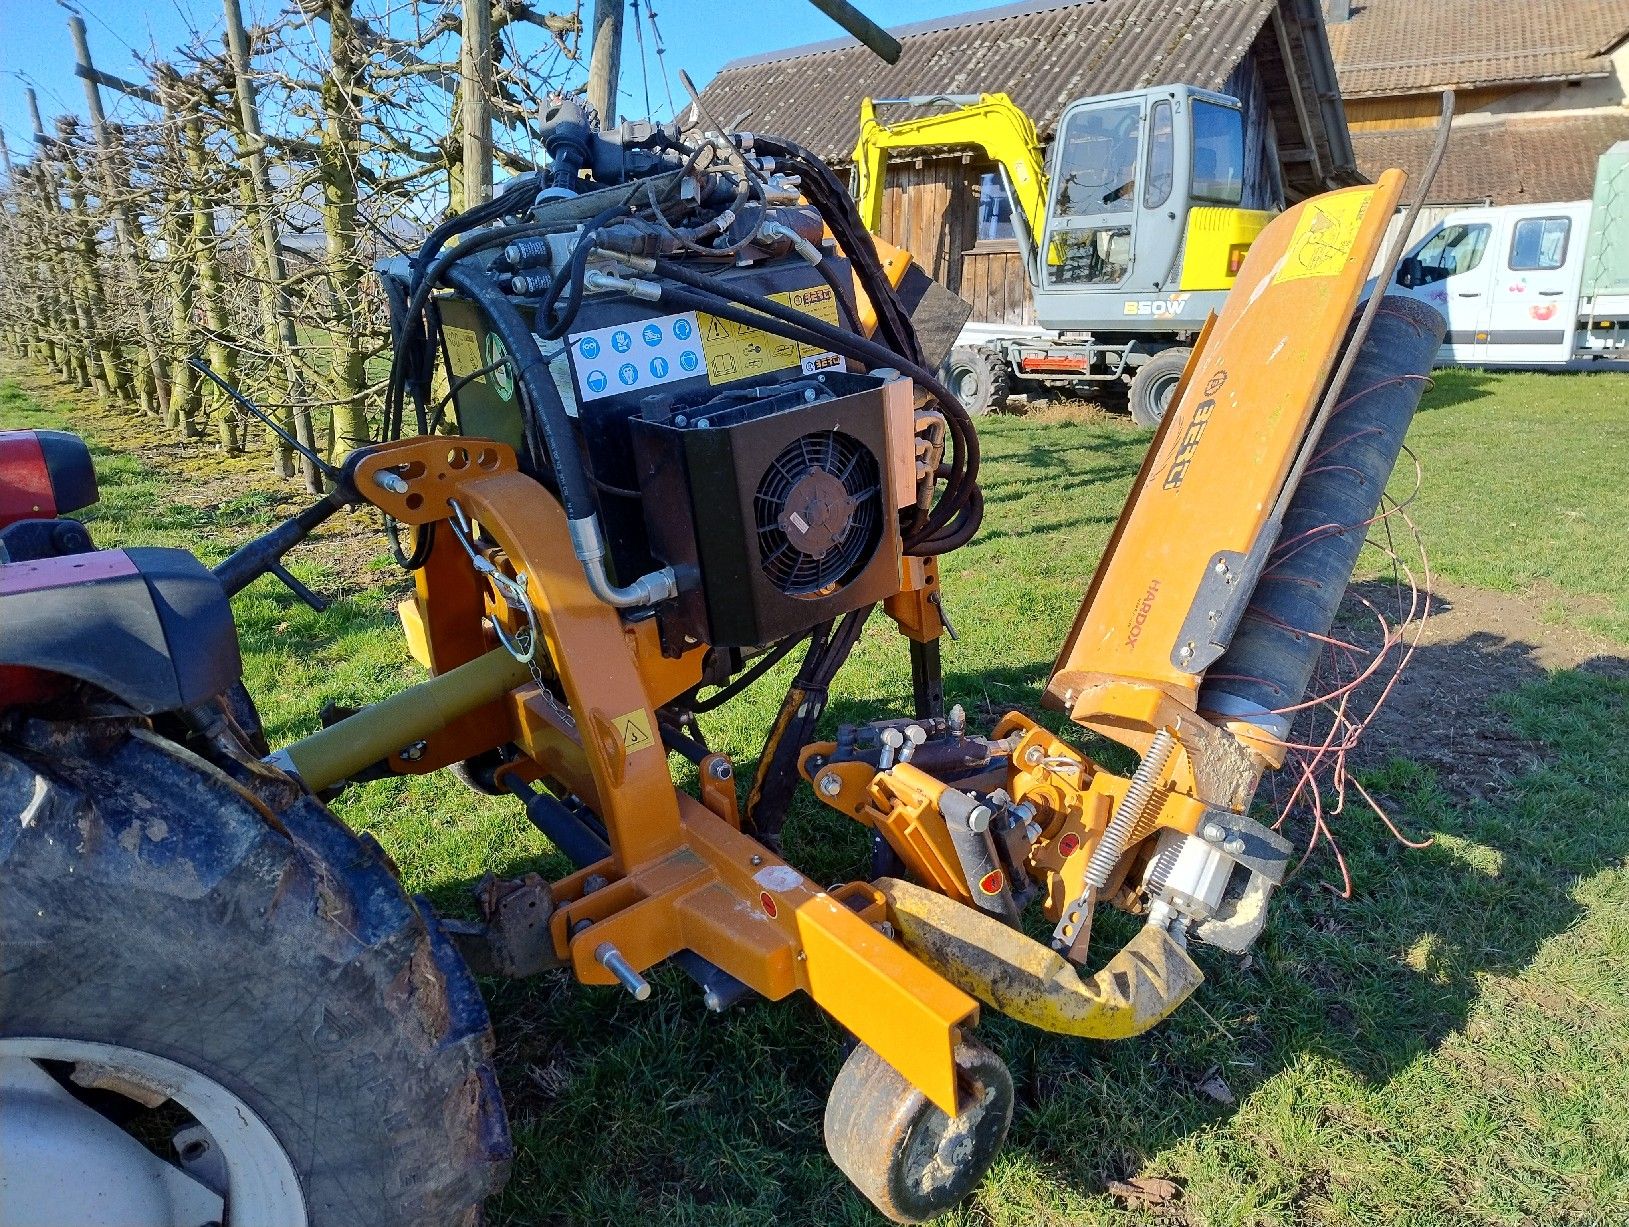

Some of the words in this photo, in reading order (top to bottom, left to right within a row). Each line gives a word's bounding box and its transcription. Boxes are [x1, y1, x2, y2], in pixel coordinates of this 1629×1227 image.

[1175, 101, 1181, 114] 2
[1163, 398, 1216, 491] BERTI
[1125, 579, 1161, 648] HARDOX
